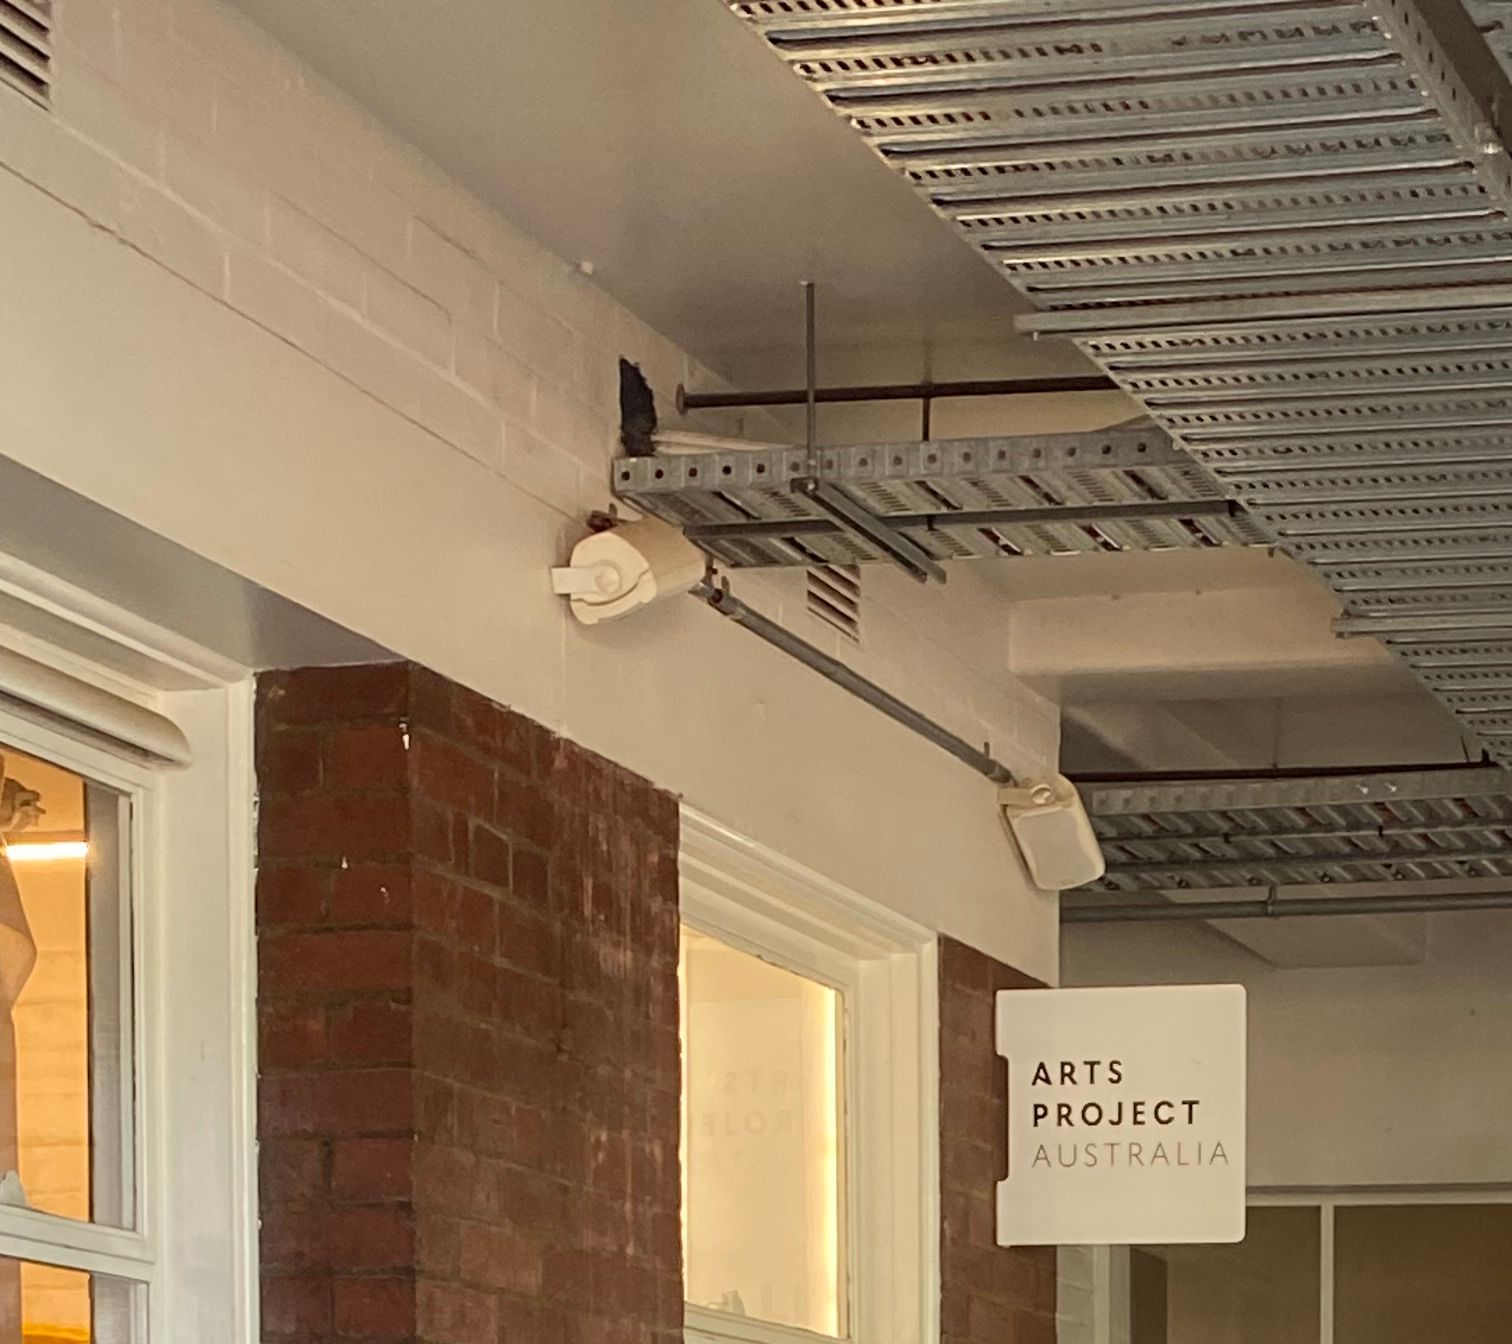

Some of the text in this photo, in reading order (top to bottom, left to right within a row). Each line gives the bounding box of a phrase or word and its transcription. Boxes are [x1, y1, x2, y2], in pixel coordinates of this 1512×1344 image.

[1031, 1060, 1123, 1086] ARTS
[1032, 1100, 1200, 1127] PROJECT
[1031, 1141, 1230, 1168] AUSTRALIA
